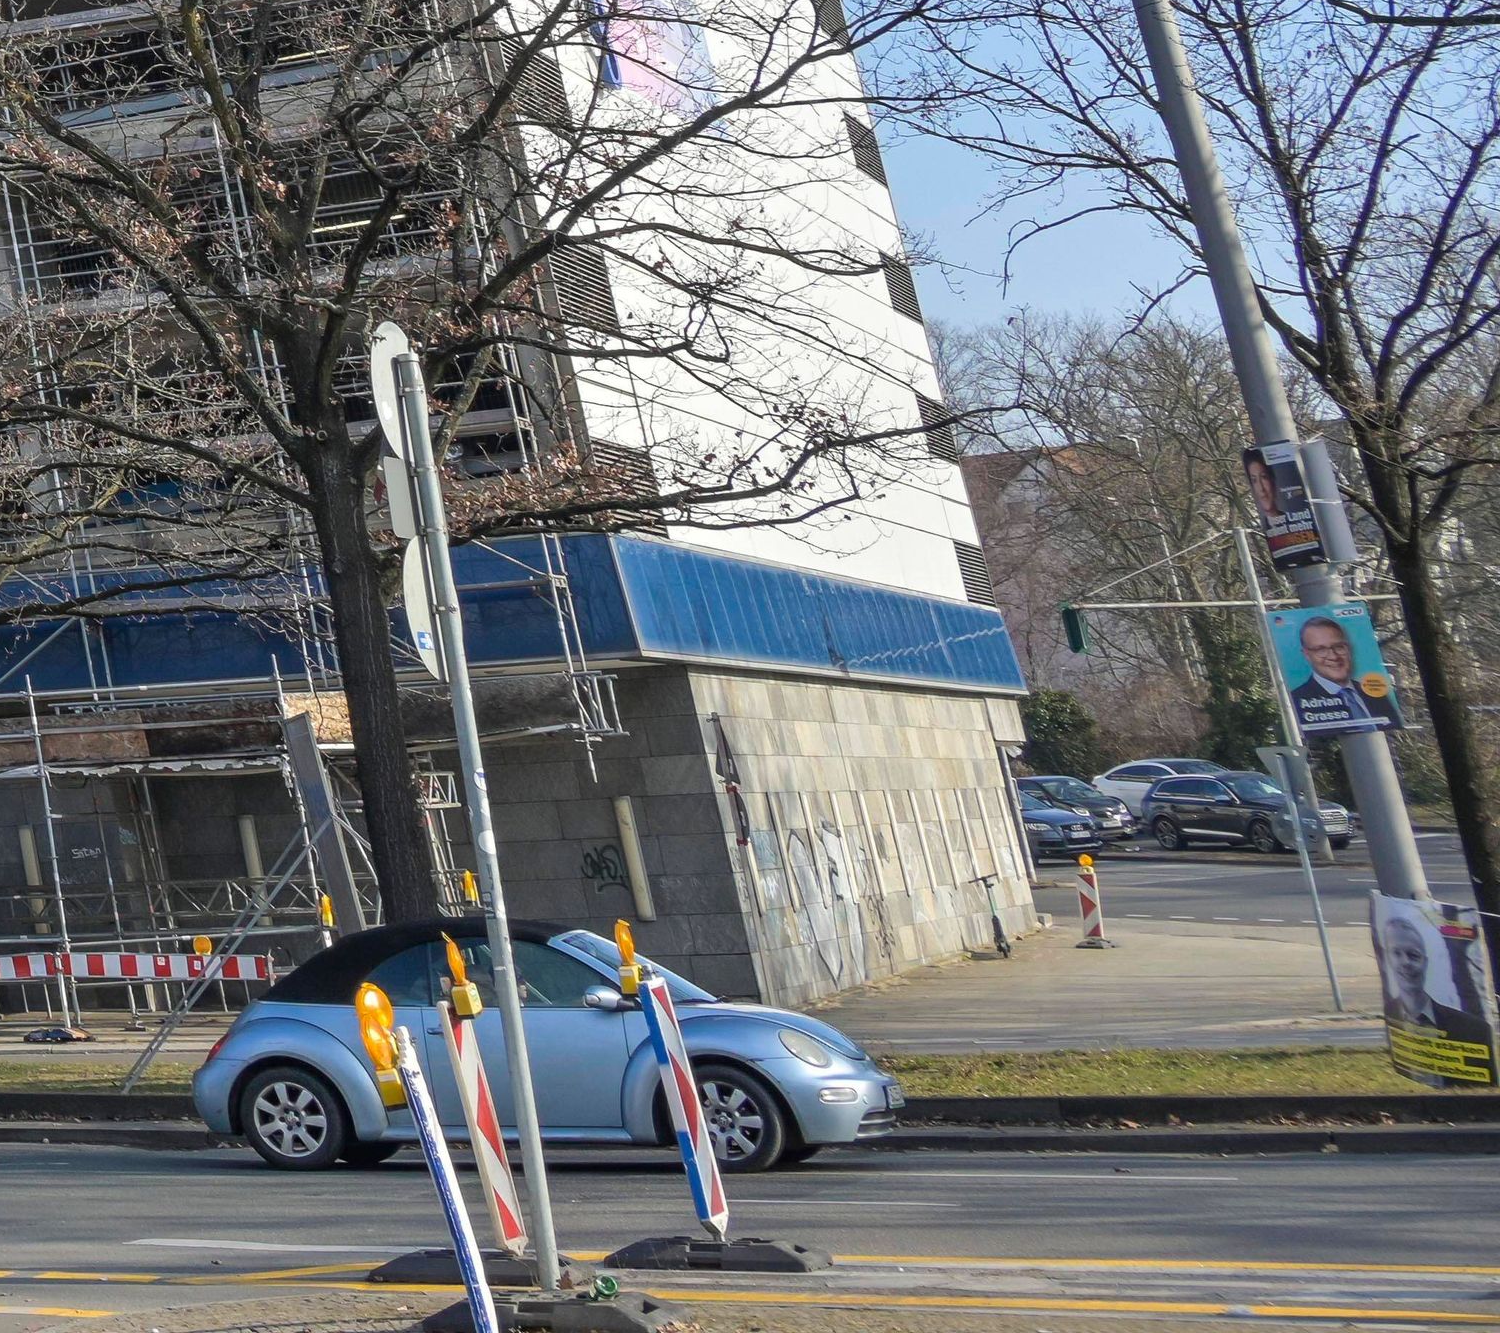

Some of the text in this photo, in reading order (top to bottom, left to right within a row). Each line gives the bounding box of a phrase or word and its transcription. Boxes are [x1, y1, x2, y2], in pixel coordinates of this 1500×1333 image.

[1341, 608, 1362, 616] CDU
[1301, 697, 1343, 709] Adrian
[1305, 710, 1349, 722] Grasse
